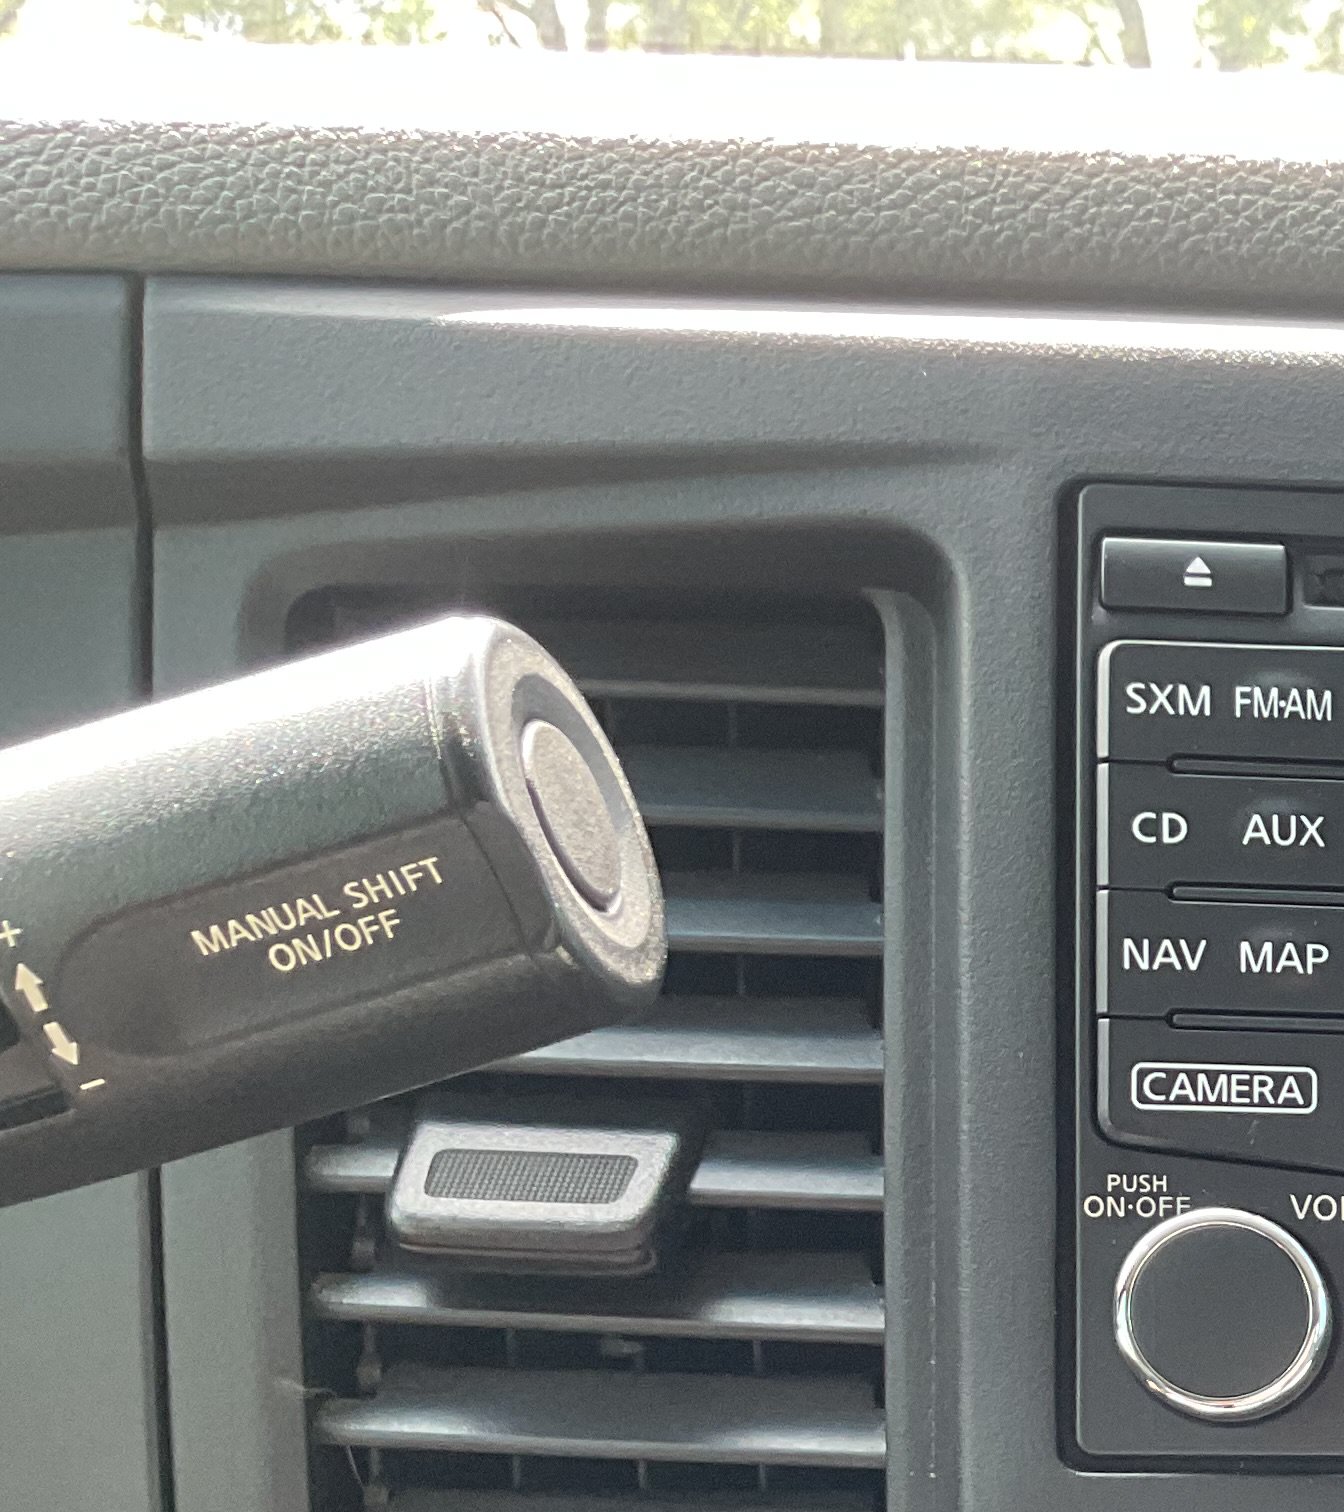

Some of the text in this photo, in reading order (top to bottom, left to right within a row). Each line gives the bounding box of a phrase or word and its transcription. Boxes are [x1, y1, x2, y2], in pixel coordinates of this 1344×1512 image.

[1125, 682, 1212, 717] SXM
[1131, 812, 1188, 844] CD
[1242, 814, 1326, 847] AUX
[190, 856, 444, 956] MANUAL SHIFT
[267, 908, 402, 972] ON/OFF
[1122, 938, 1207, 971] NAV
[1239, 941, 1330, 974] MAP
[1142, 1072, 1305, 1105] CAMERA
[1106, 1174, 1168, 1193] PUSH
